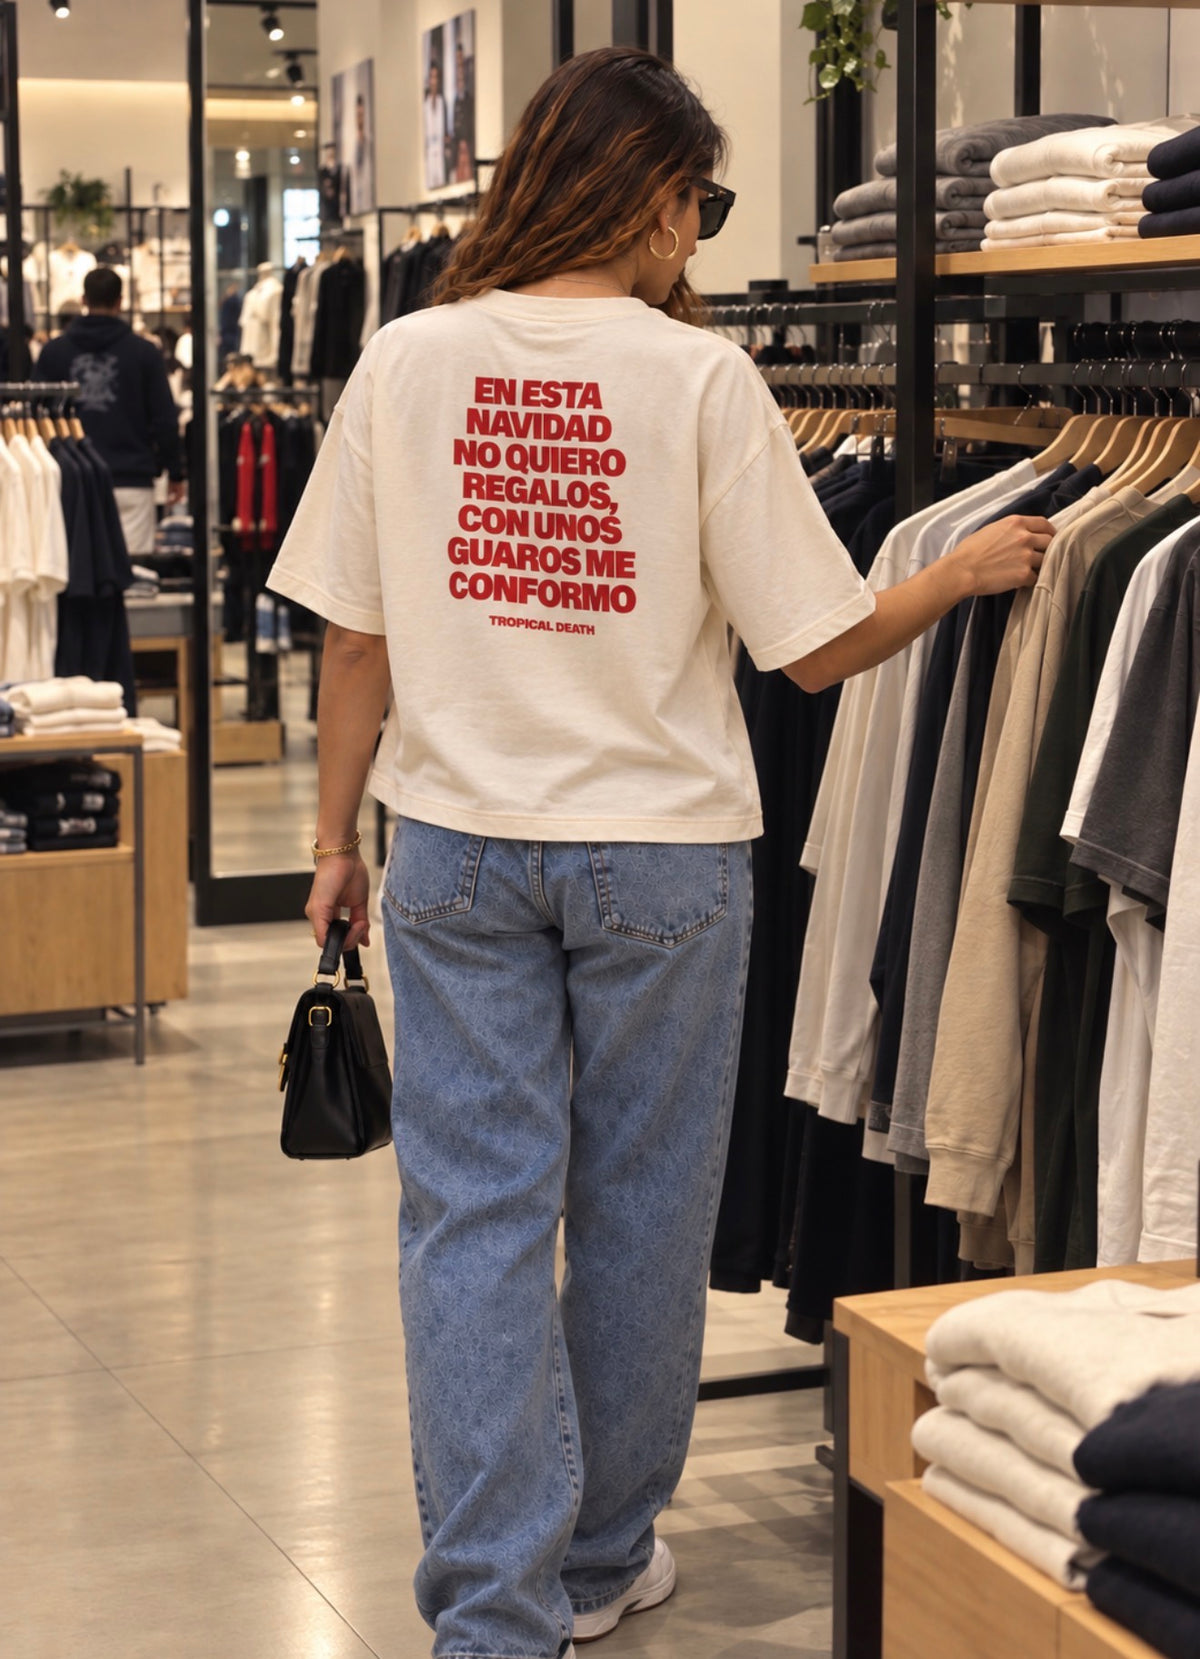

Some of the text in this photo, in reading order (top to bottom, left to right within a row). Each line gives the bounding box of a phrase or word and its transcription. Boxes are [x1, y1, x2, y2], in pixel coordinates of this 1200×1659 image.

[475, 377, 602, 409] EN ESTA
[467, 408, 612, 442] NAVIDAD
[454, 439, 626, 477] NO QUIERO
[463, 472, 618, 515] REGALOS,
[458, 505, 622, 544] CON UNOS
[448, 537, 636, 579] GUAROS ME
[449, 571, 637, 613] CONFORMO
[489, 616, 595, 634] TROPICAL DEATH
